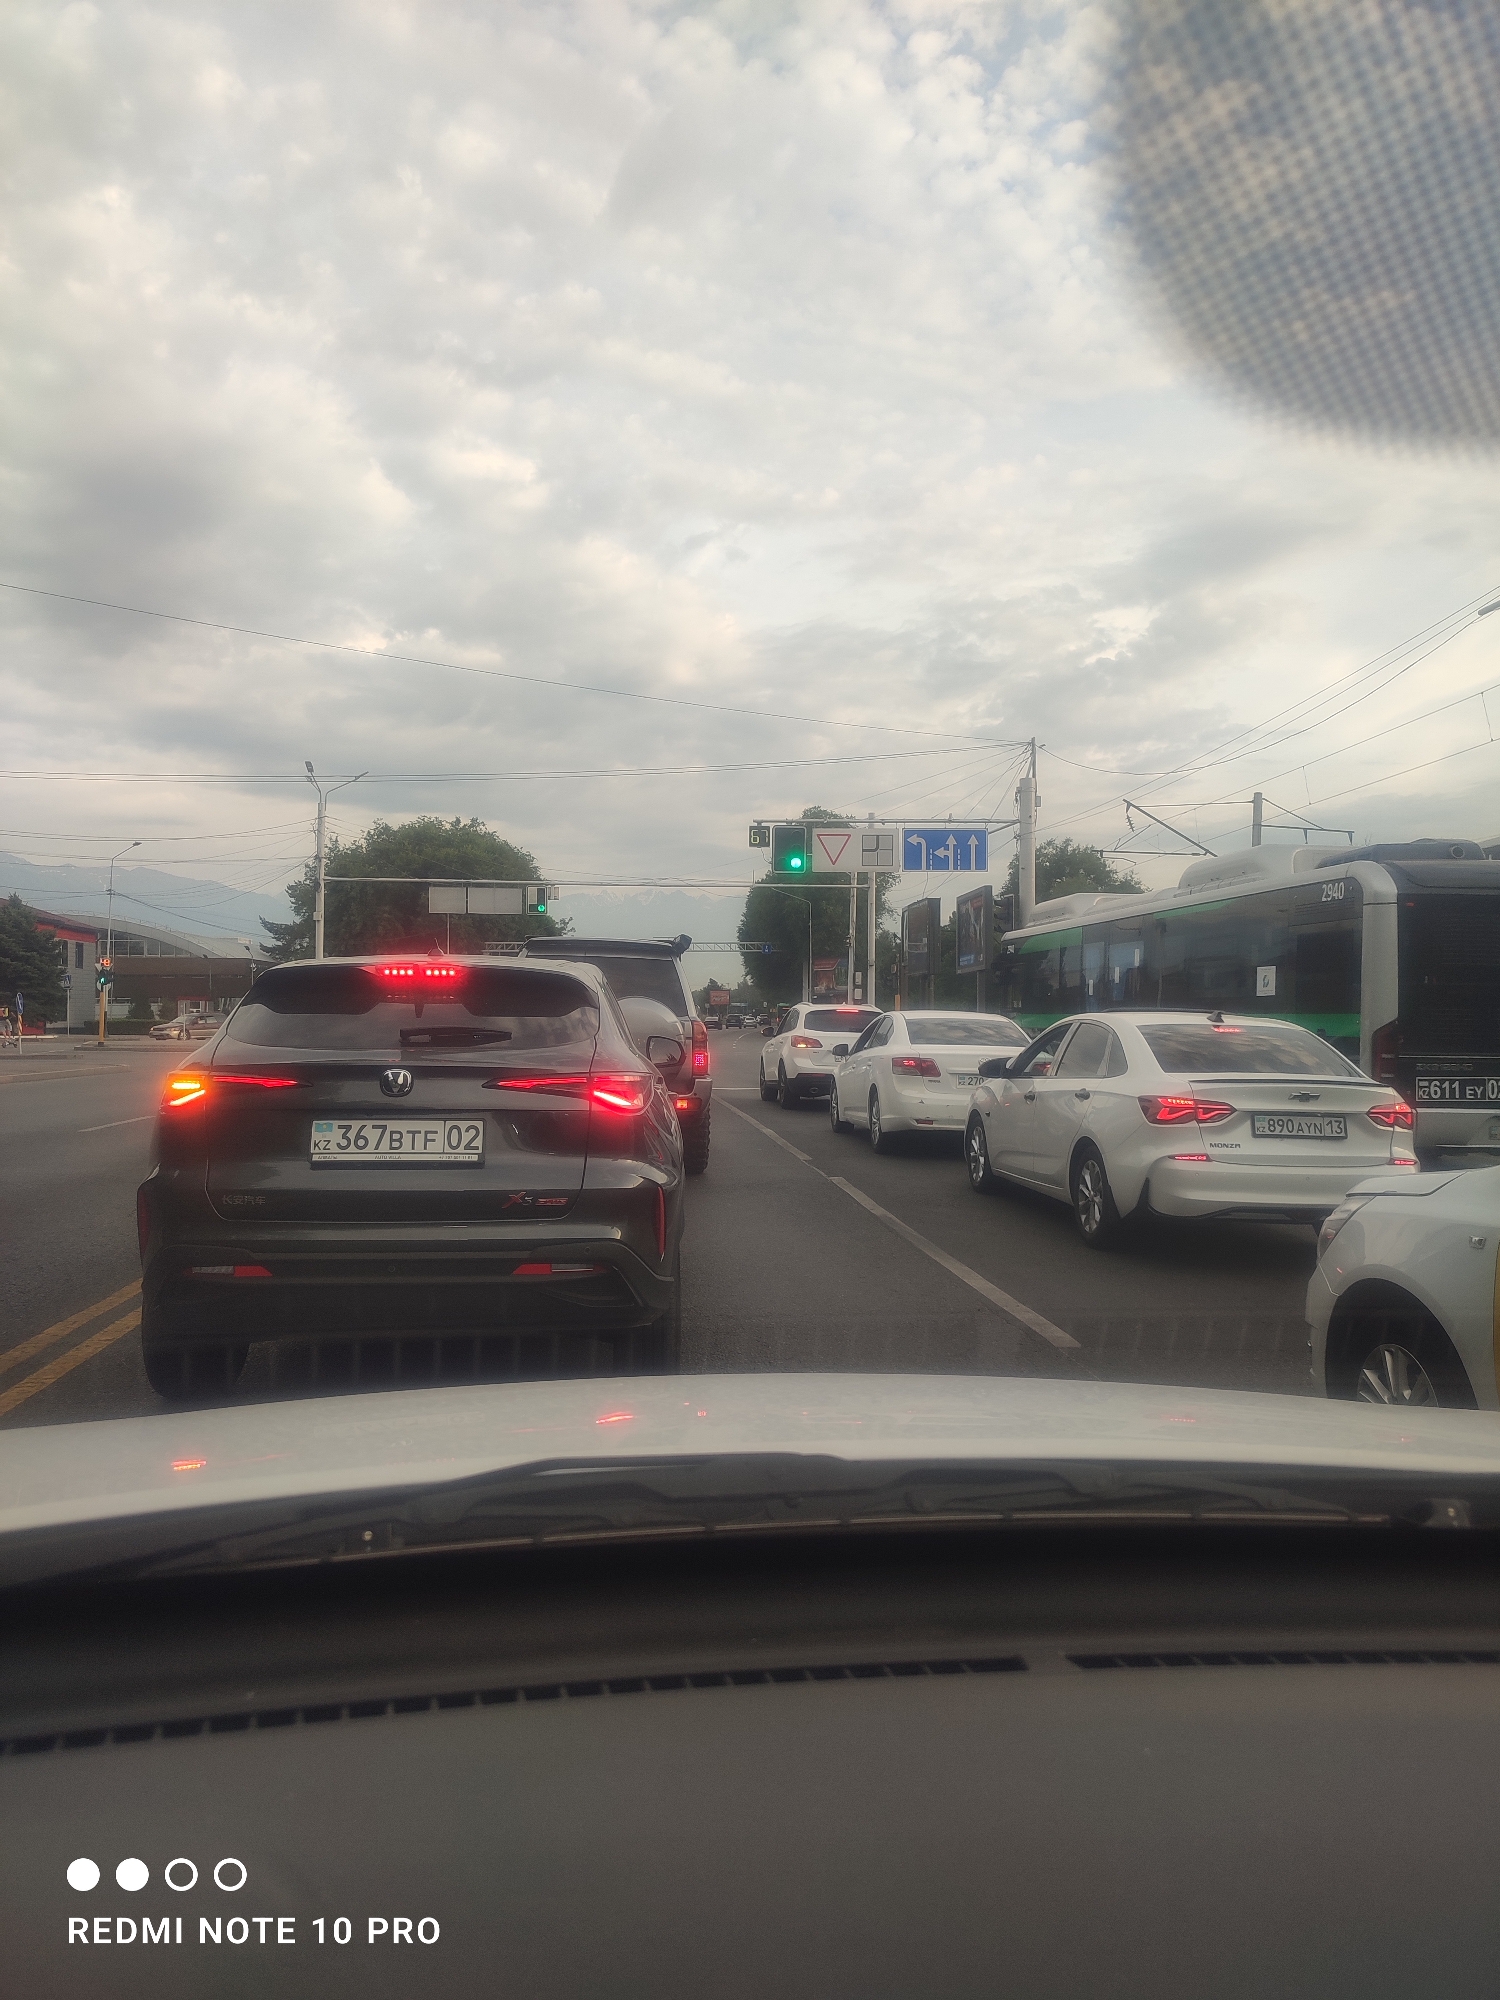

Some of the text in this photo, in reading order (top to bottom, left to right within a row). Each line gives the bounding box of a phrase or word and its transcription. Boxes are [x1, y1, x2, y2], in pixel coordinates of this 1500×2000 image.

[1321, 881, 1345, 902] 2940
[1418, 1087, 1430, 1099] KZ
[1430, 1080, 1460, 1099] 611
[1465, 1086, 1484, 1099] EY
[1267, 1118, 1323, 1135] 890AYN
[1325, 1119, 1343, 1135] 13
[313, 1124, 480, 1151] KZ 367BTF 02
[221, 1194, 266, 1206] 长安汽车
